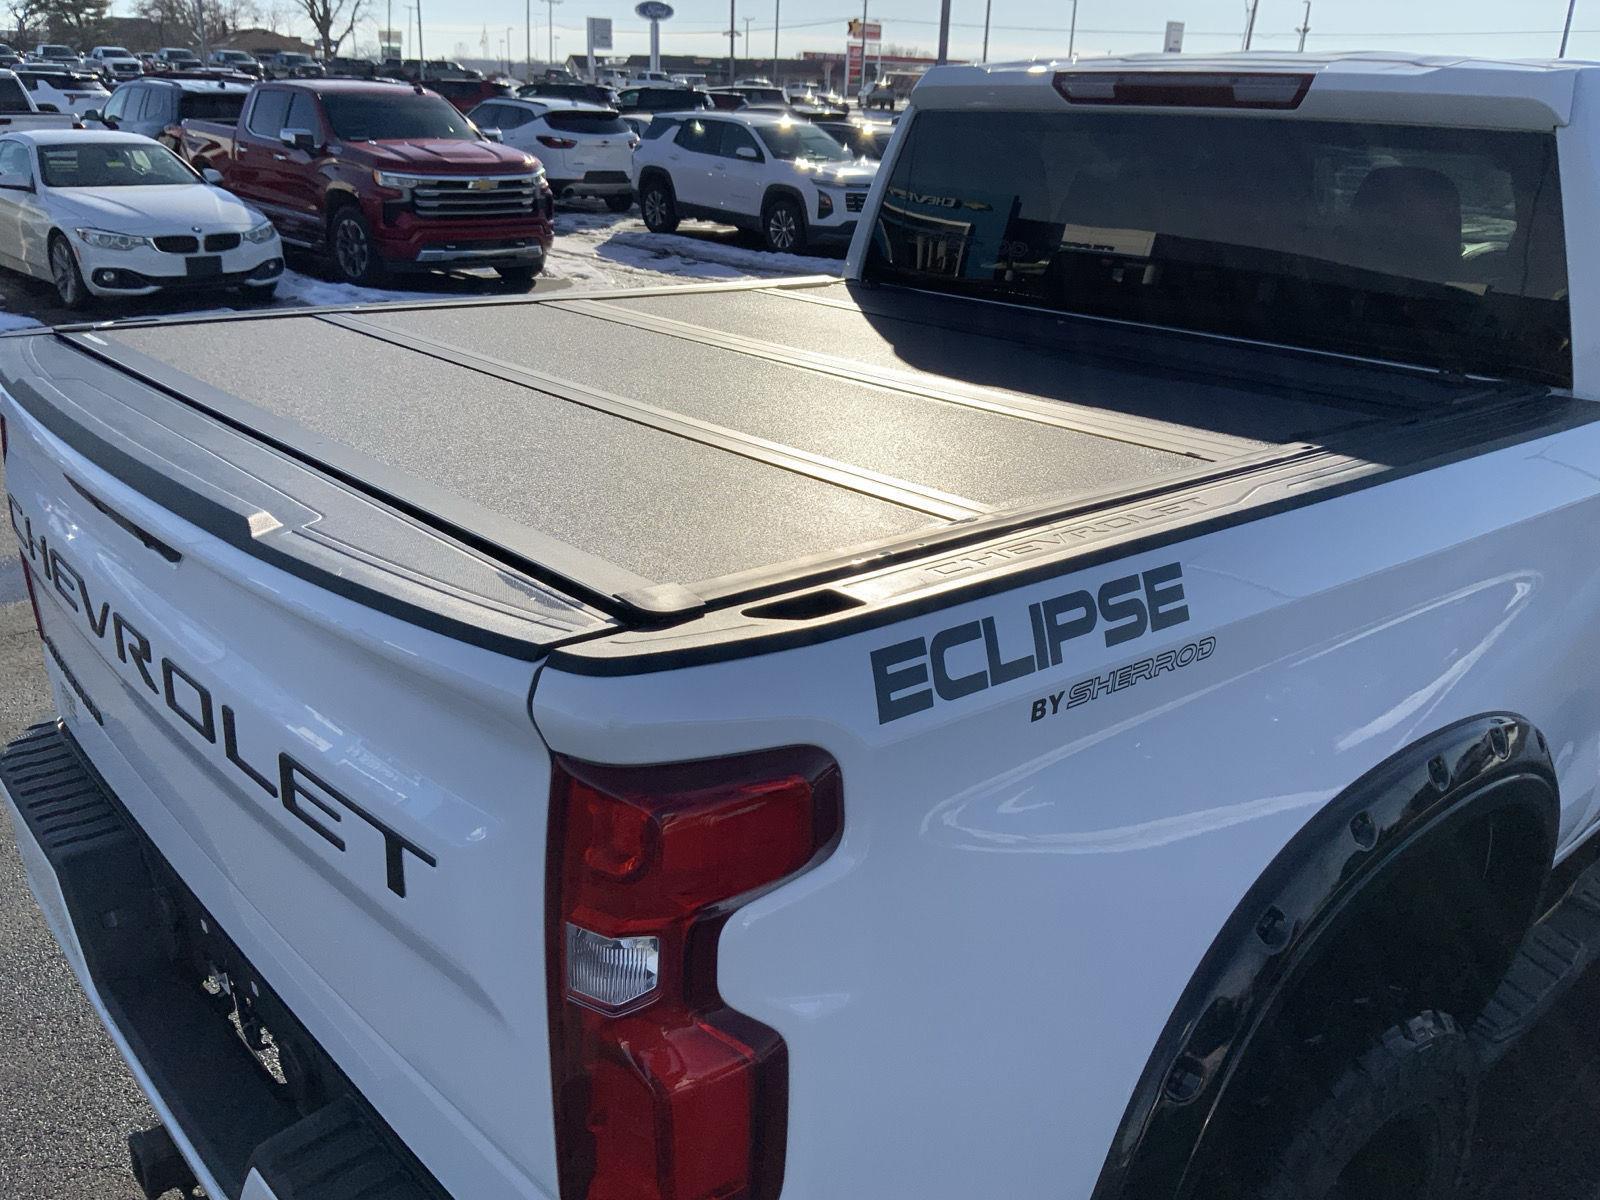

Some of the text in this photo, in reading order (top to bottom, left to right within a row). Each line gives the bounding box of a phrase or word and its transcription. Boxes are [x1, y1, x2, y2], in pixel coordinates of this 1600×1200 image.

[924, 497, 1208, 576] CHEVROLET
[7, 493, 436, 898] CHEVROLET
[870, 561, 1189, 725] ECLIPSE
[1031, 636, 1216, 722] BY SHERROD
